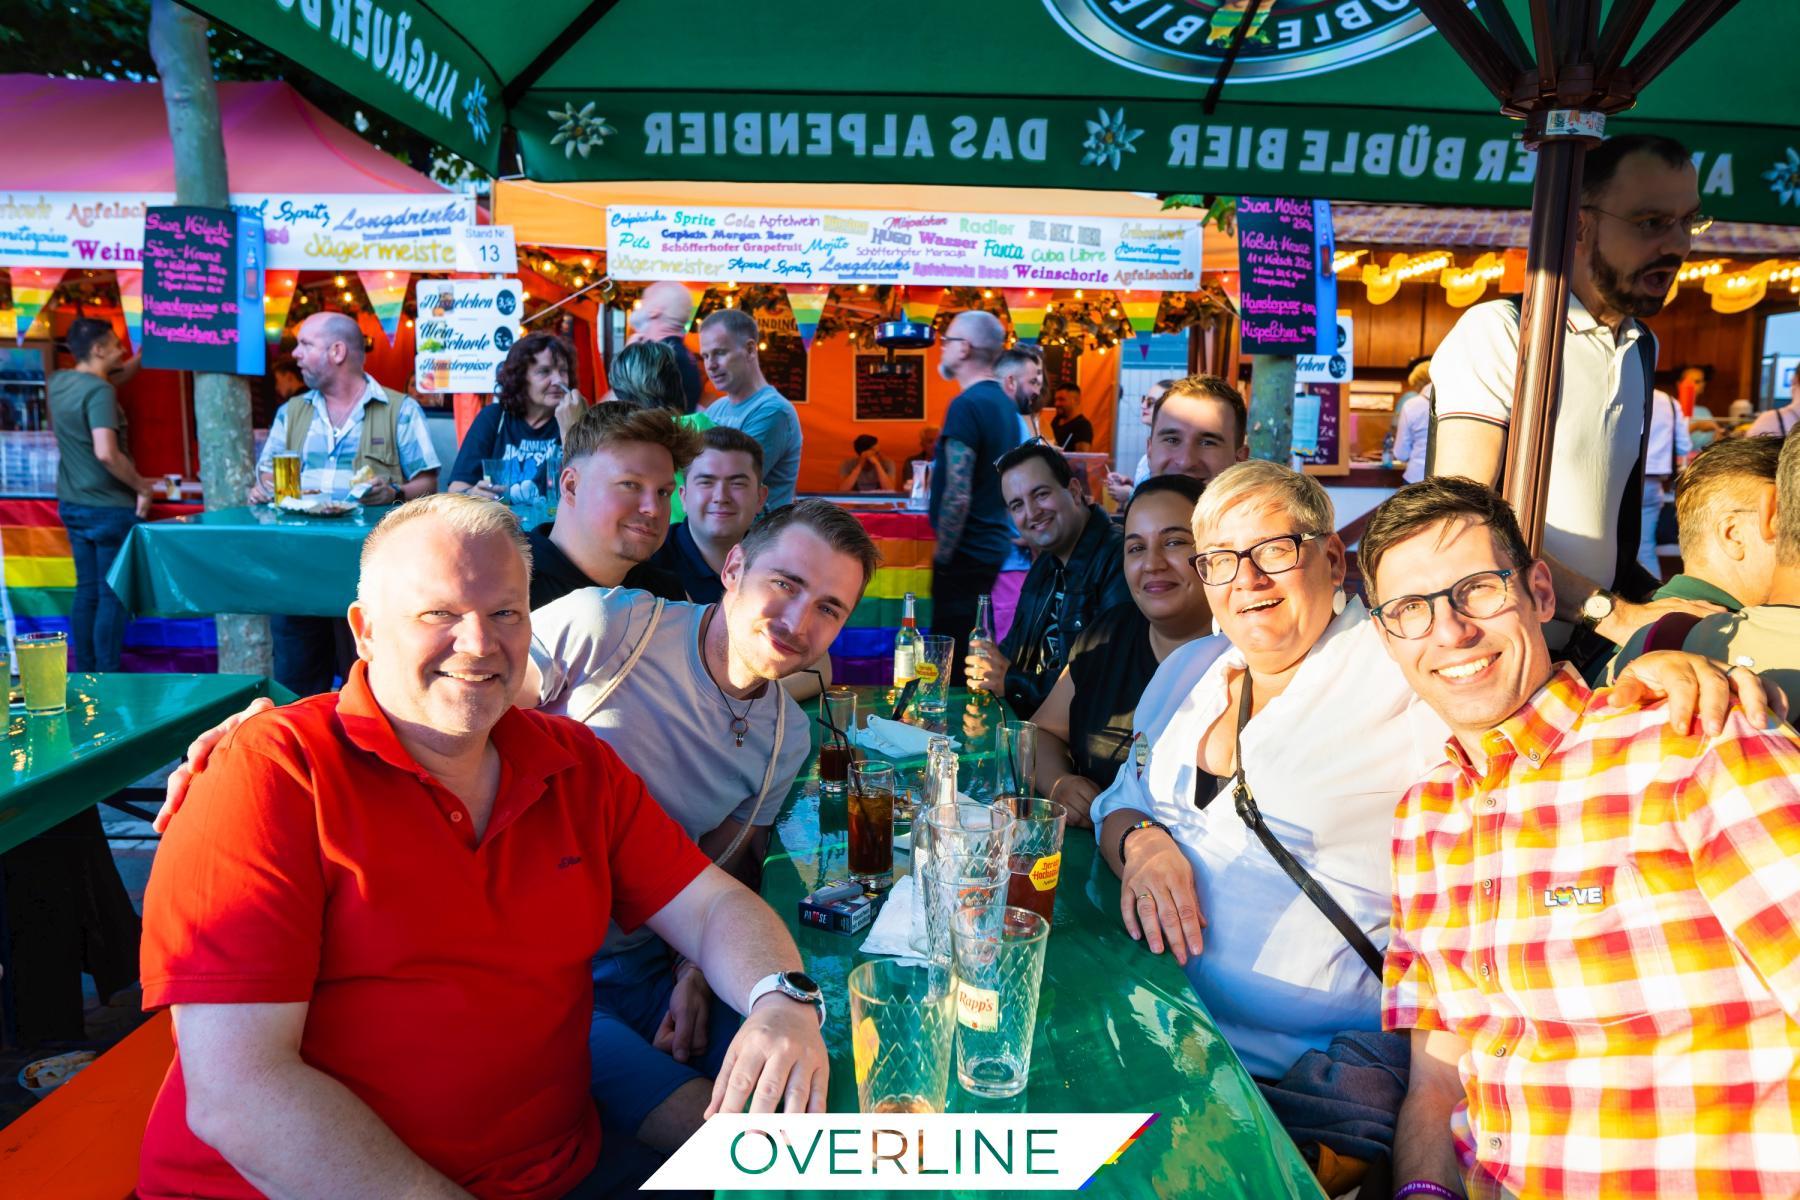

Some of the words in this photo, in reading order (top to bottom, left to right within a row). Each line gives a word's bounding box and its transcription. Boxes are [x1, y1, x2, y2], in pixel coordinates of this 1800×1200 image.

[273, 200, 330, 228] Spritz
[333, 202, 468, 233] Longdrinks
[673, 210, 716, 227] Sprite
[723, 212, 756, 229] Cola
[759, 214, 820, 230] Apfelwein
[465, 228, 493, 239] Stand
[661, 229, 707, 242] Captain
[712, 230, 760, 242] Morgan
[959, 217, 1016, 236] Radler
[619, 232, 651, 250] Pils
[870, 227, 912, 246] HUGO
[919, 230, 979, 249] Wasser
[304, 233, 456, 264] Jägermeiste
[479, 244, 501, 263] 13
[661, 242, 740, 253] Schöfferhofer
[743, 242, 802, 253] Grapefruit
[801, 236, 850, 257] Mojito
[984, 239, 1025, 260] Fanta
[1031, 247, 1065, 263] Cuba
[1070, 248, 1107, 263] Libre
[611, 253, 726, 276] Jägermeister
[819, 256, 911, 273] Longdrinks
[1013, 264, 1109, 284] Weinschorle
[1114, 269, 1194, 286] Apfelschorle
[757, 318, 798, 331] INDING
[959, 991, 993, 1013] Rapp's
